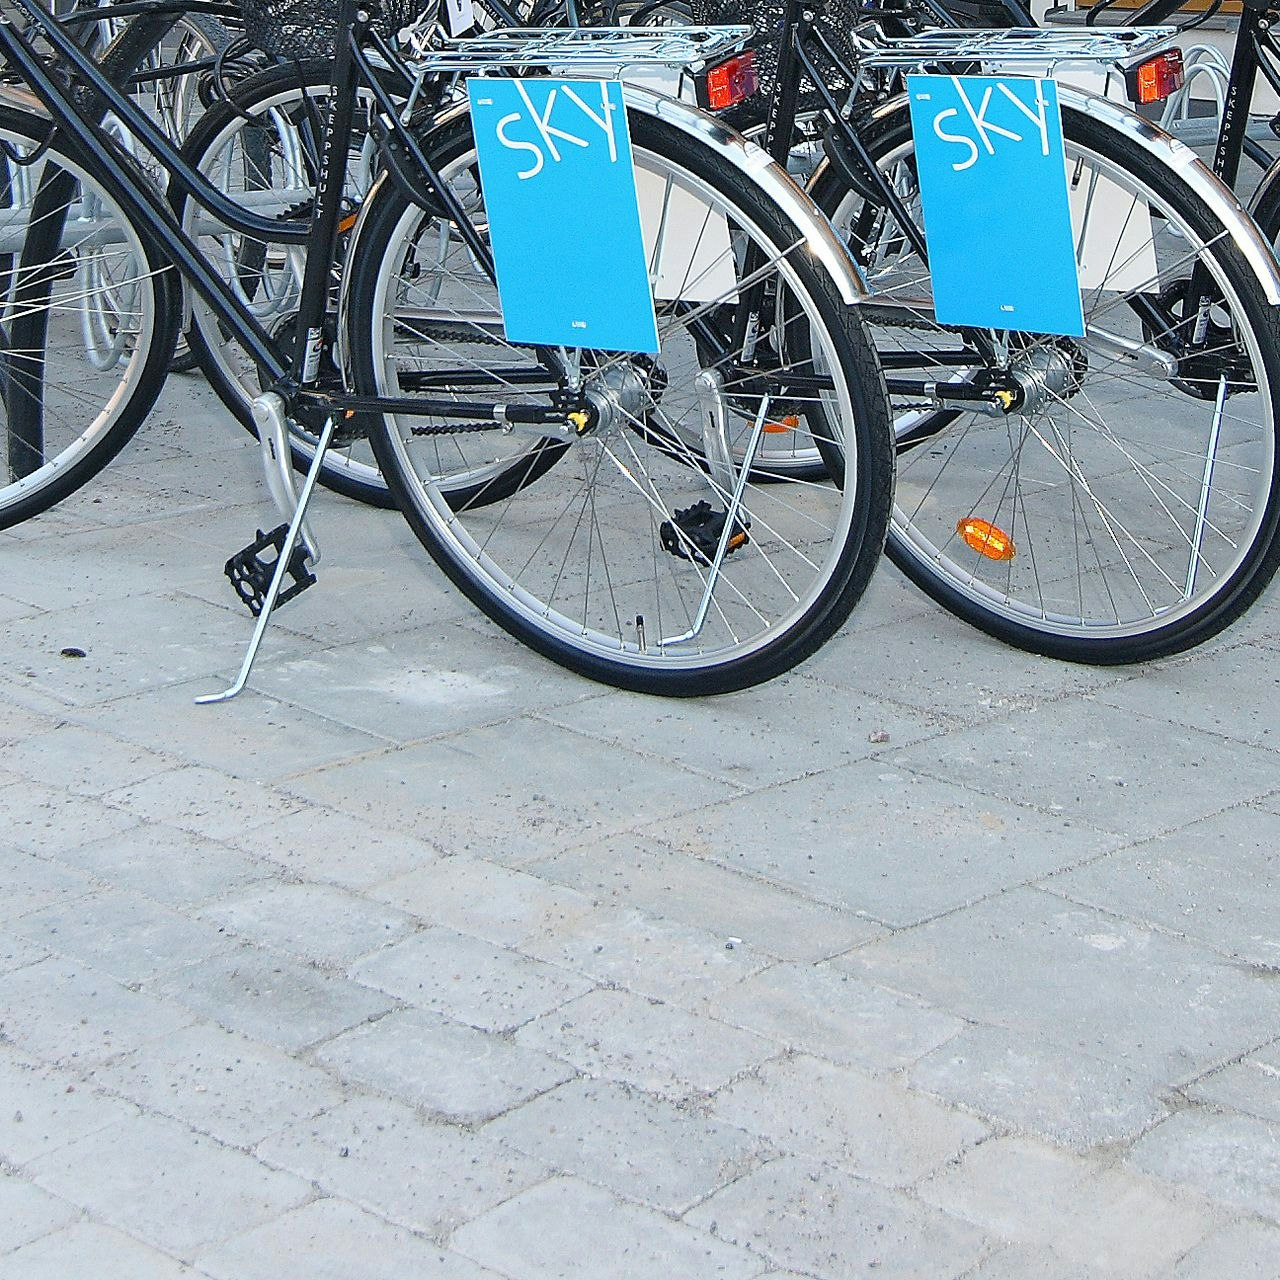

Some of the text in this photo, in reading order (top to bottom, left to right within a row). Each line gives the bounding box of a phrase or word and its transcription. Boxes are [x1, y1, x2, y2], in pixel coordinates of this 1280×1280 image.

[315, 85, 339, 219] SKEPPSHULT
[496, 79, 618, 180] SKY
[933, 76, 1051, 171] SKY
